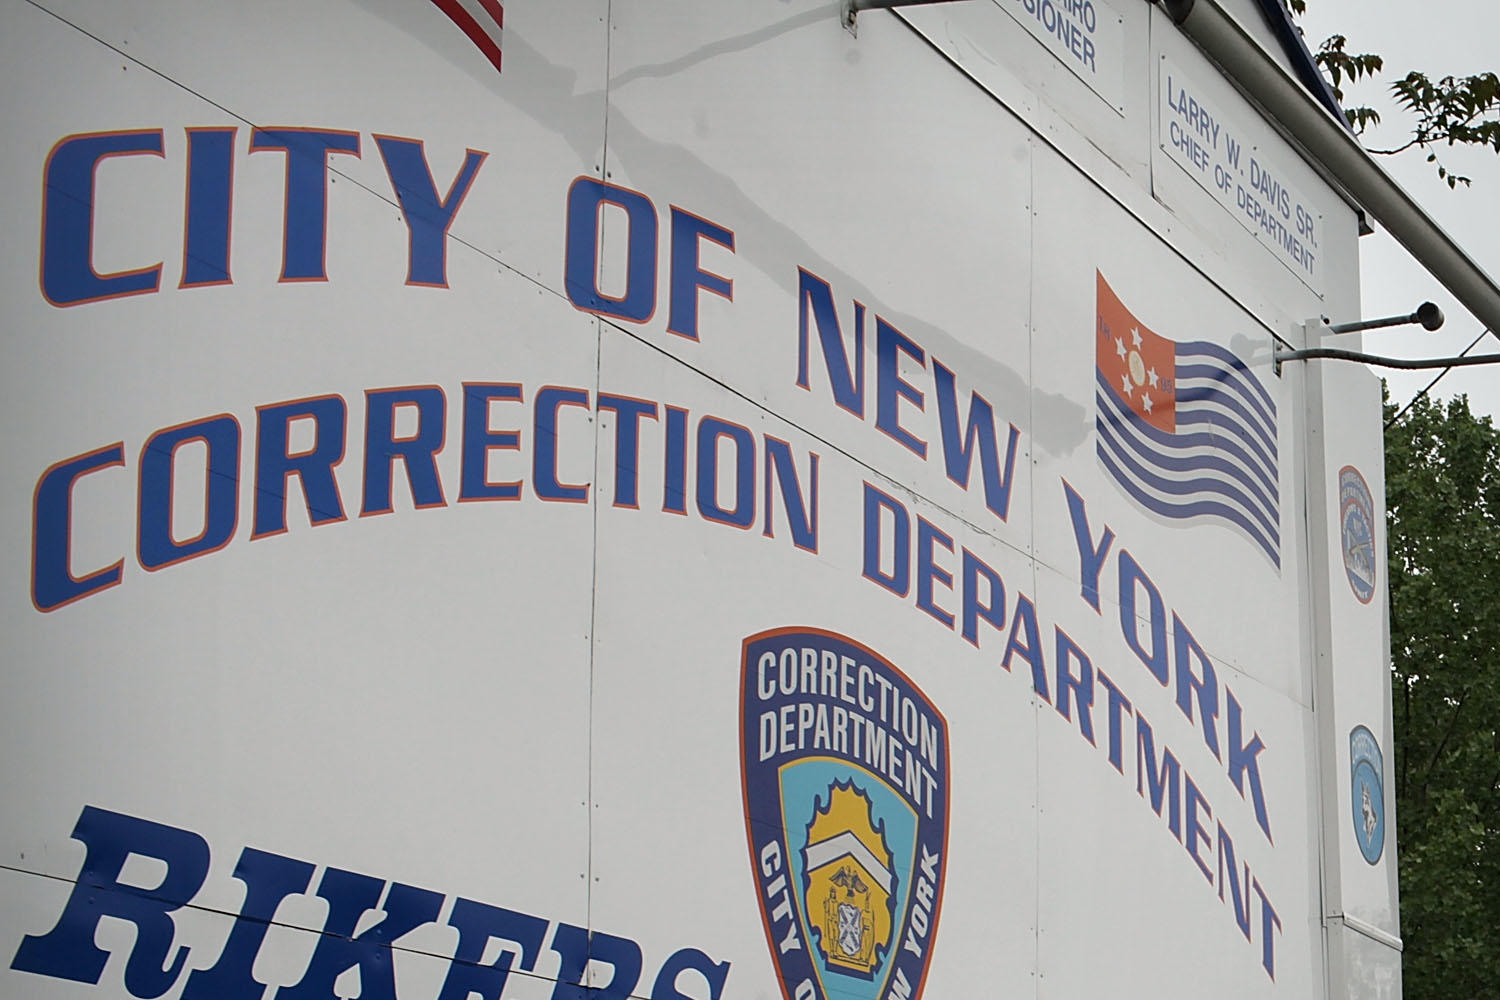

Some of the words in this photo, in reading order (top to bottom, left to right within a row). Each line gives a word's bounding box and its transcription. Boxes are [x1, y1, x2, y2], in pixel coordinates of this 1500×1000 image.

[1167, 76, 1220, 150] LARRY
[1226, 133, 1244, 177] W.
[1250, 157, 1291, 222] DAVIS
[1295, 202, 1319, 249] SR.
[1169, 121, 1210, 173] CHIEF
[1214, 163, 1233, 194] OF
[1236, 183, 1316, 275] DEPARTMENT
[39, 125, 490, 308] CITY
[563, 174, 735, 343] OF
[795, 265, 1021, 523] NEW
[1060, 475, 1275, 847] YORK
[31, 381, 820, 613] CORRECTION
[861, 479, 1283, 984] DEPARTMENT
[757, 646, 938, 772] CORRECTION
[759, 701, 938, 819] DEPARTMENT
[760, 838, 802, 956] CITY
[904, 842, 941, 960] YORK
